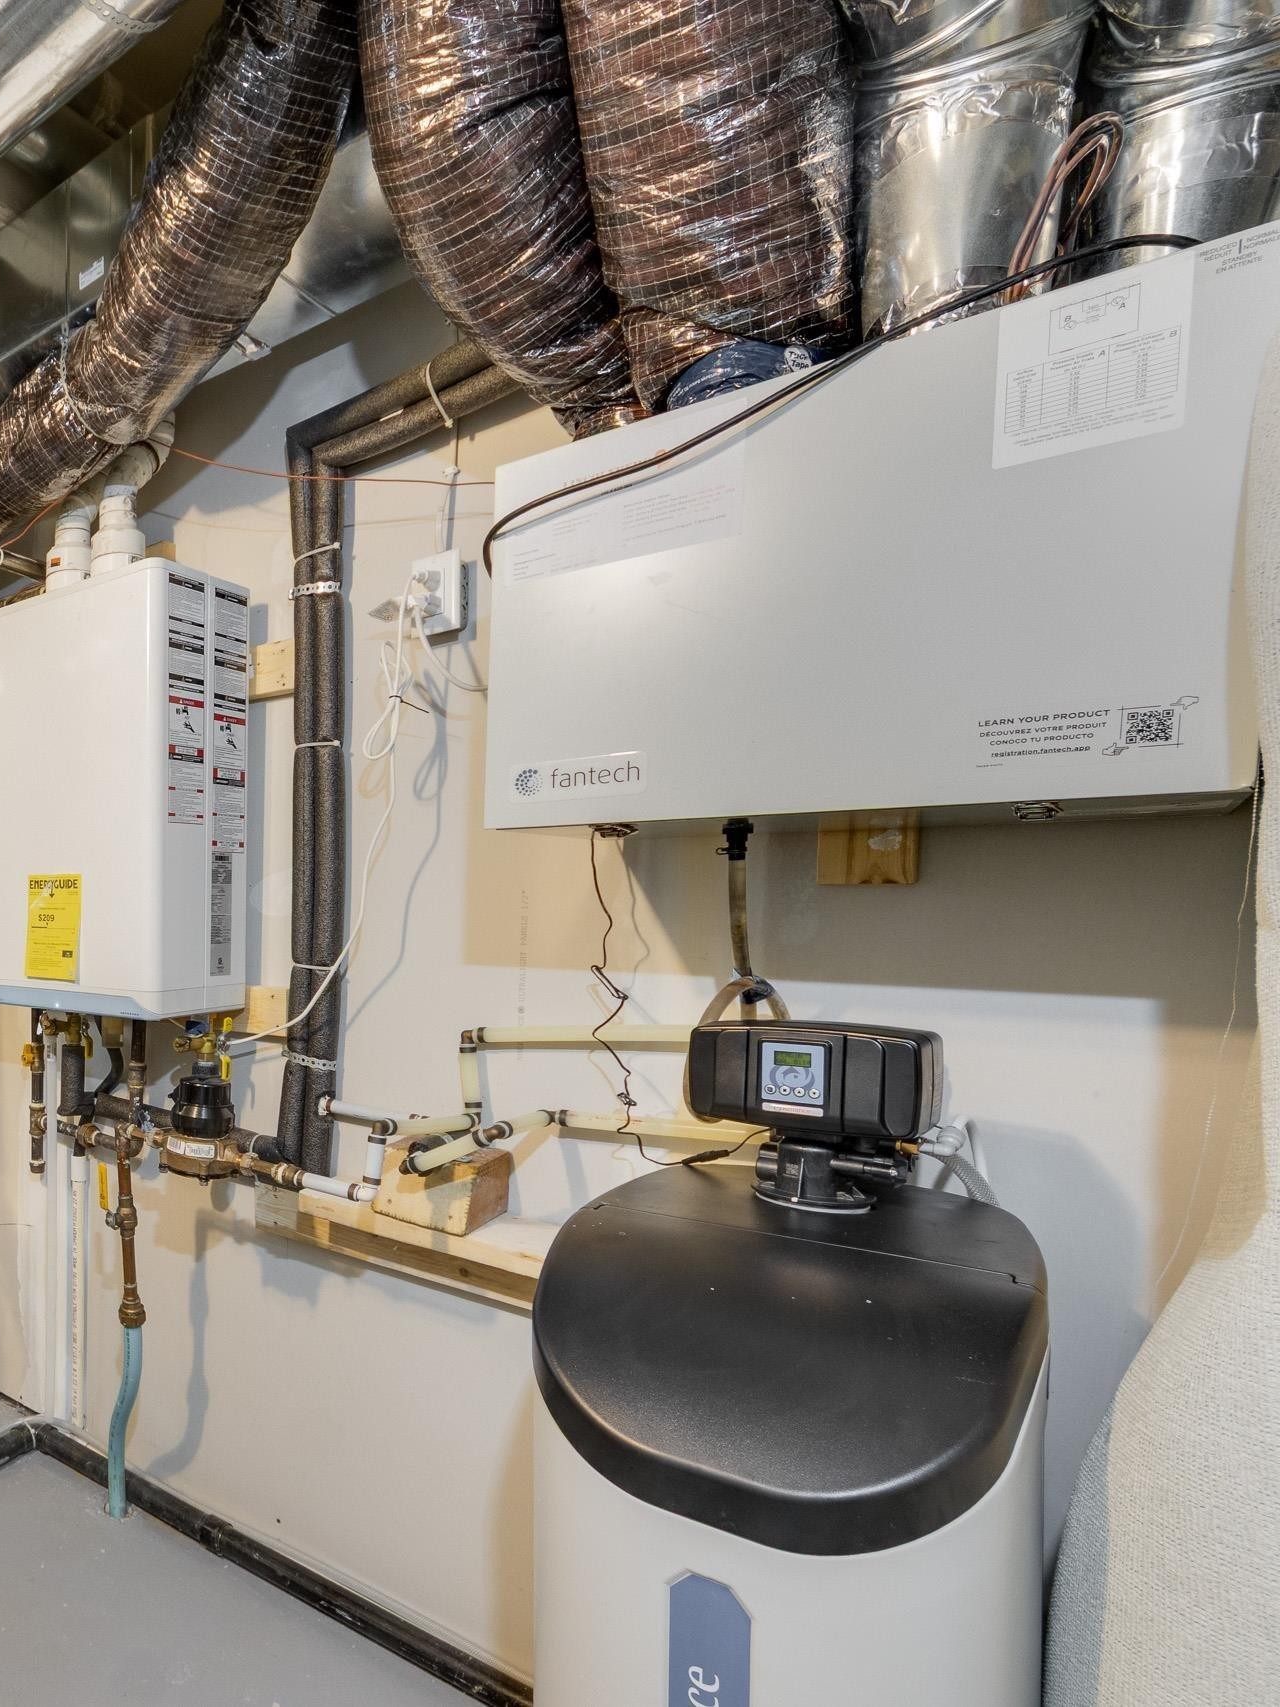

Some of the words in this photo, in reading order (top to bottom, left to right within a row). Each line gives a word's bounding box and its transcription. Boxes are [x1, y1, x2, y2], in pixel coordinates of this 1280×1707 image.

[1222, 251, 1258, 266] STANDBY
[978, 718, 1015, 727] LEARN
[1018, 715, 1050, 724] YOUR
[1053, 709, 1111, 721] PRODUCT
[979, 728, 1032, 738] DÉCOUVREZ
[1034, 725, 1064, 733] VOTRE
[1066, 722, 1108, 730] PRODUIT
[1044, 732, 1094, 742] PRODUCTO
[991, 745, 1091, 758] registration.fantech.app
[551, 760, 640, 789] fantech
